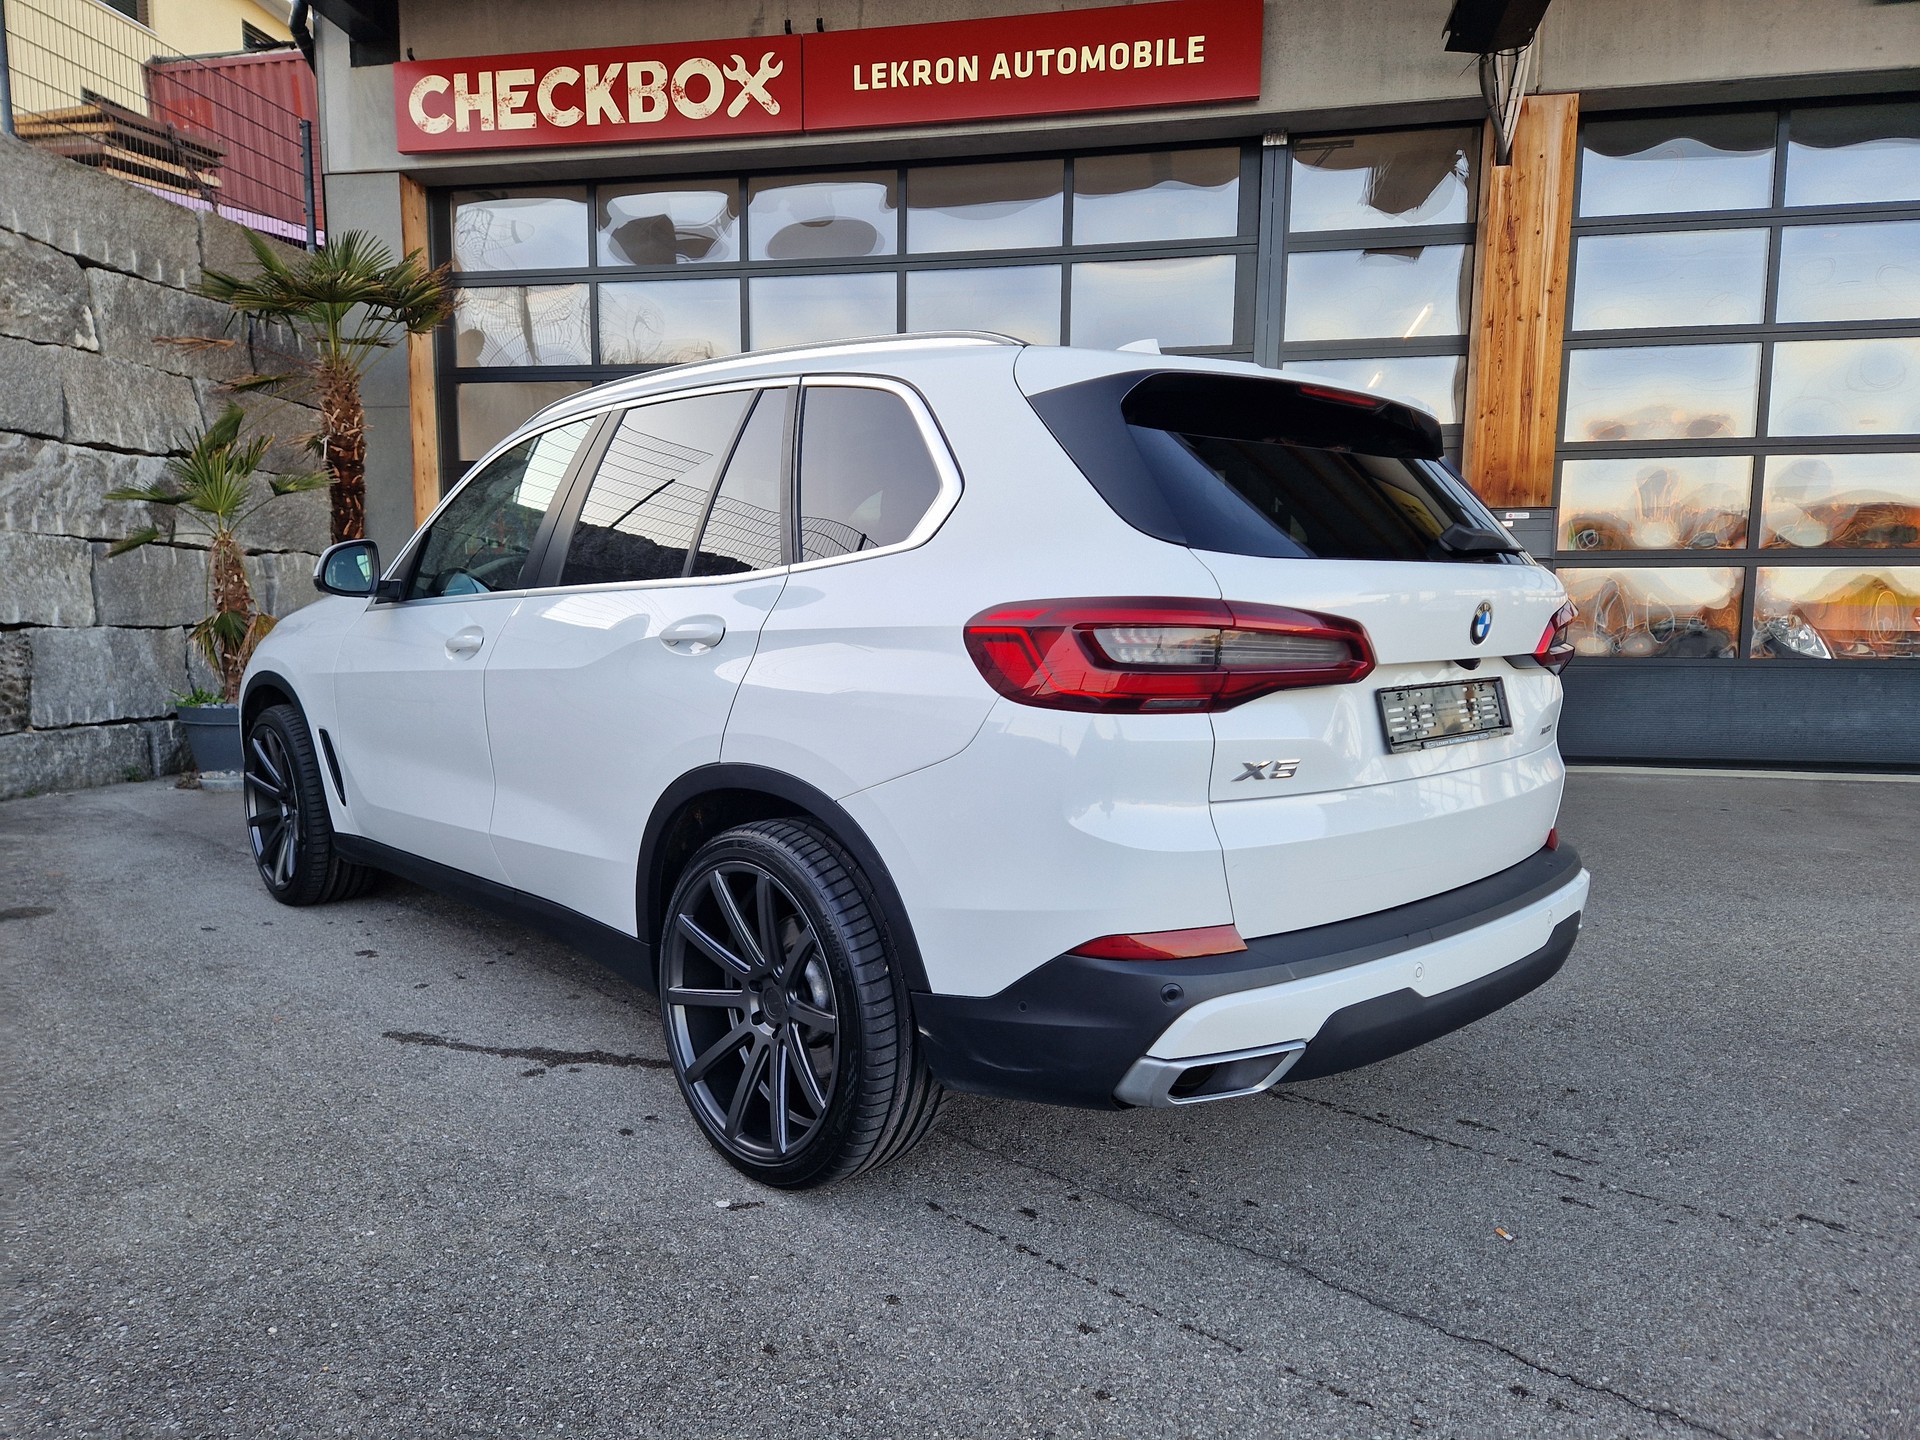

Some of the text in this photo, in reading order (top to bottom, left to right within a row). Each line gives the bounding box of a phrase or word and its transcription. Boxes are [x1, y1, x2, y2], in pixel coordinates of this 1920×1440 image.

[853, 35, 1205, 91] LEKRON AUTOMOBILE
[408, 51, 784, 135] CHECKBOX
[1230, 759, 1301, 782] X5
